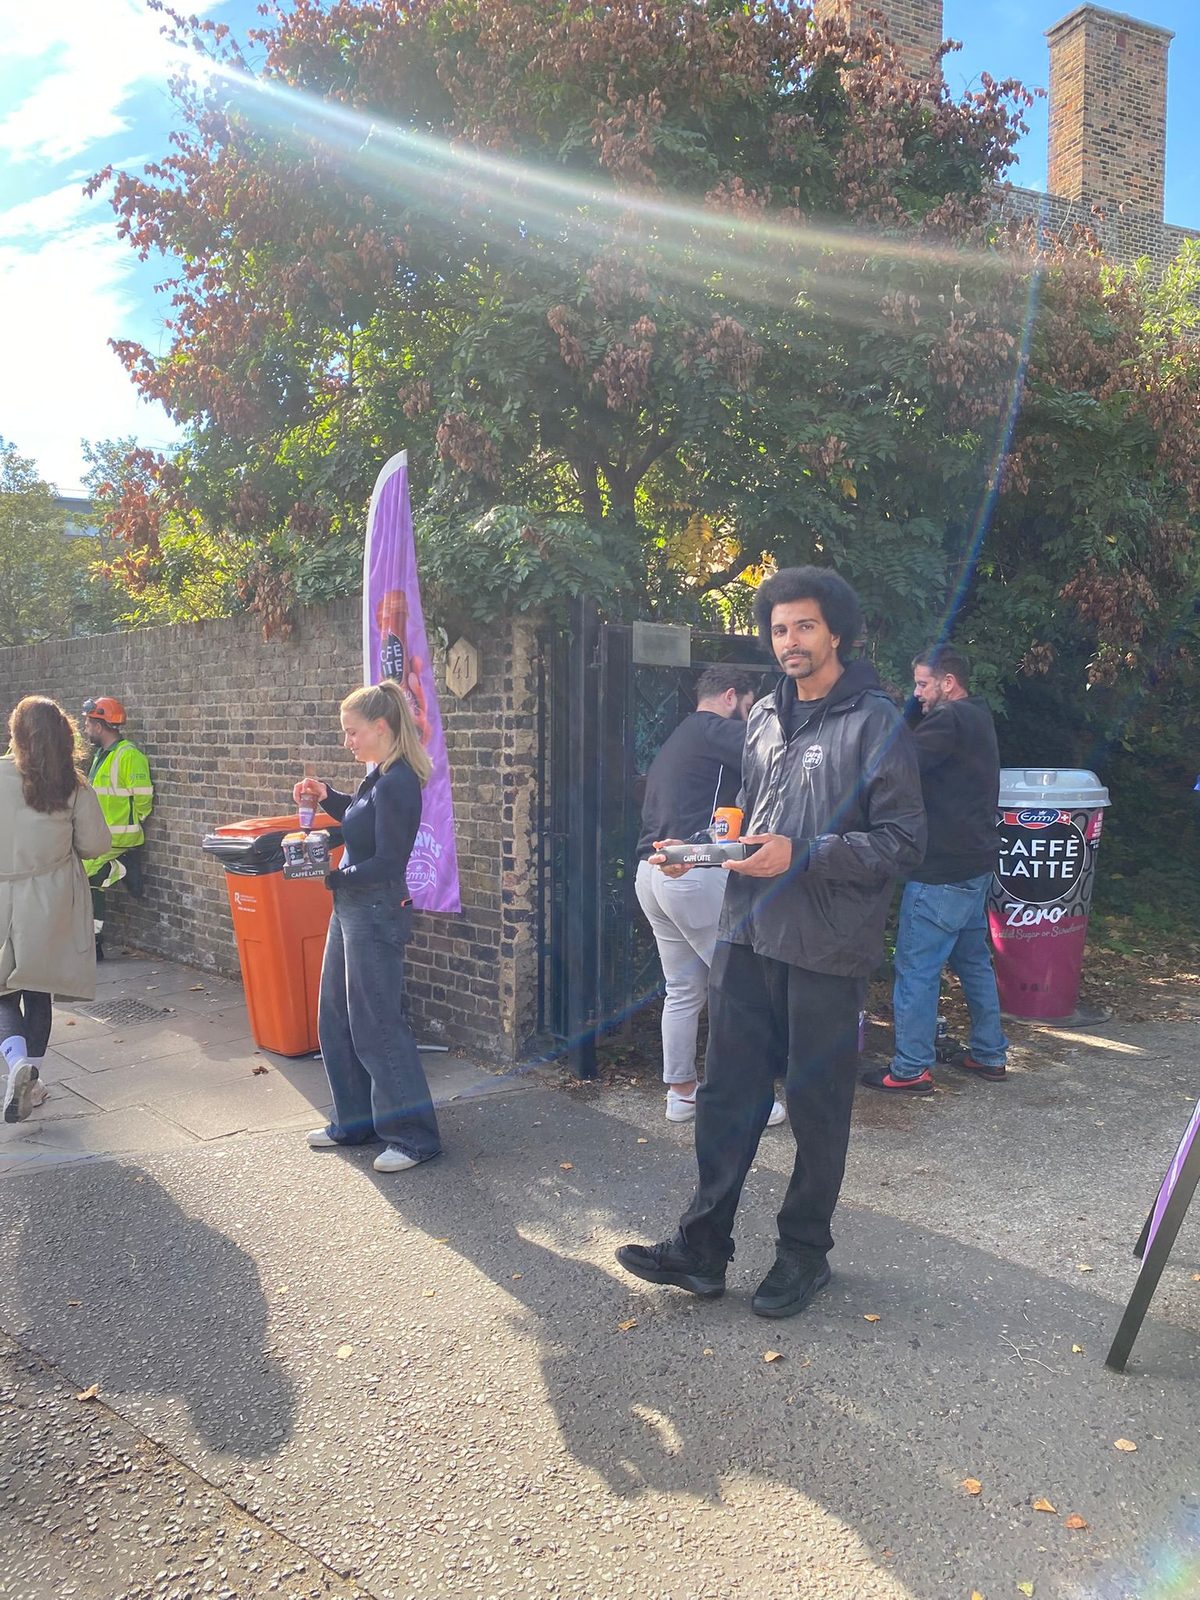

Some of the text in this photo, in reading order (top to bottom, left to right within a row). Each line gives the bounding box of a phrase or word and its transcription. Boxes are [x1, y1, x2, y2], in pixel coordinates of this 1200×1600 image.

[453, 655, 470, 680] 41
[1020, 811, 1056, 822] Emmi
[999, 858, 1075, 878] LATTE
[1005, 903, 1068, 927] Zero
